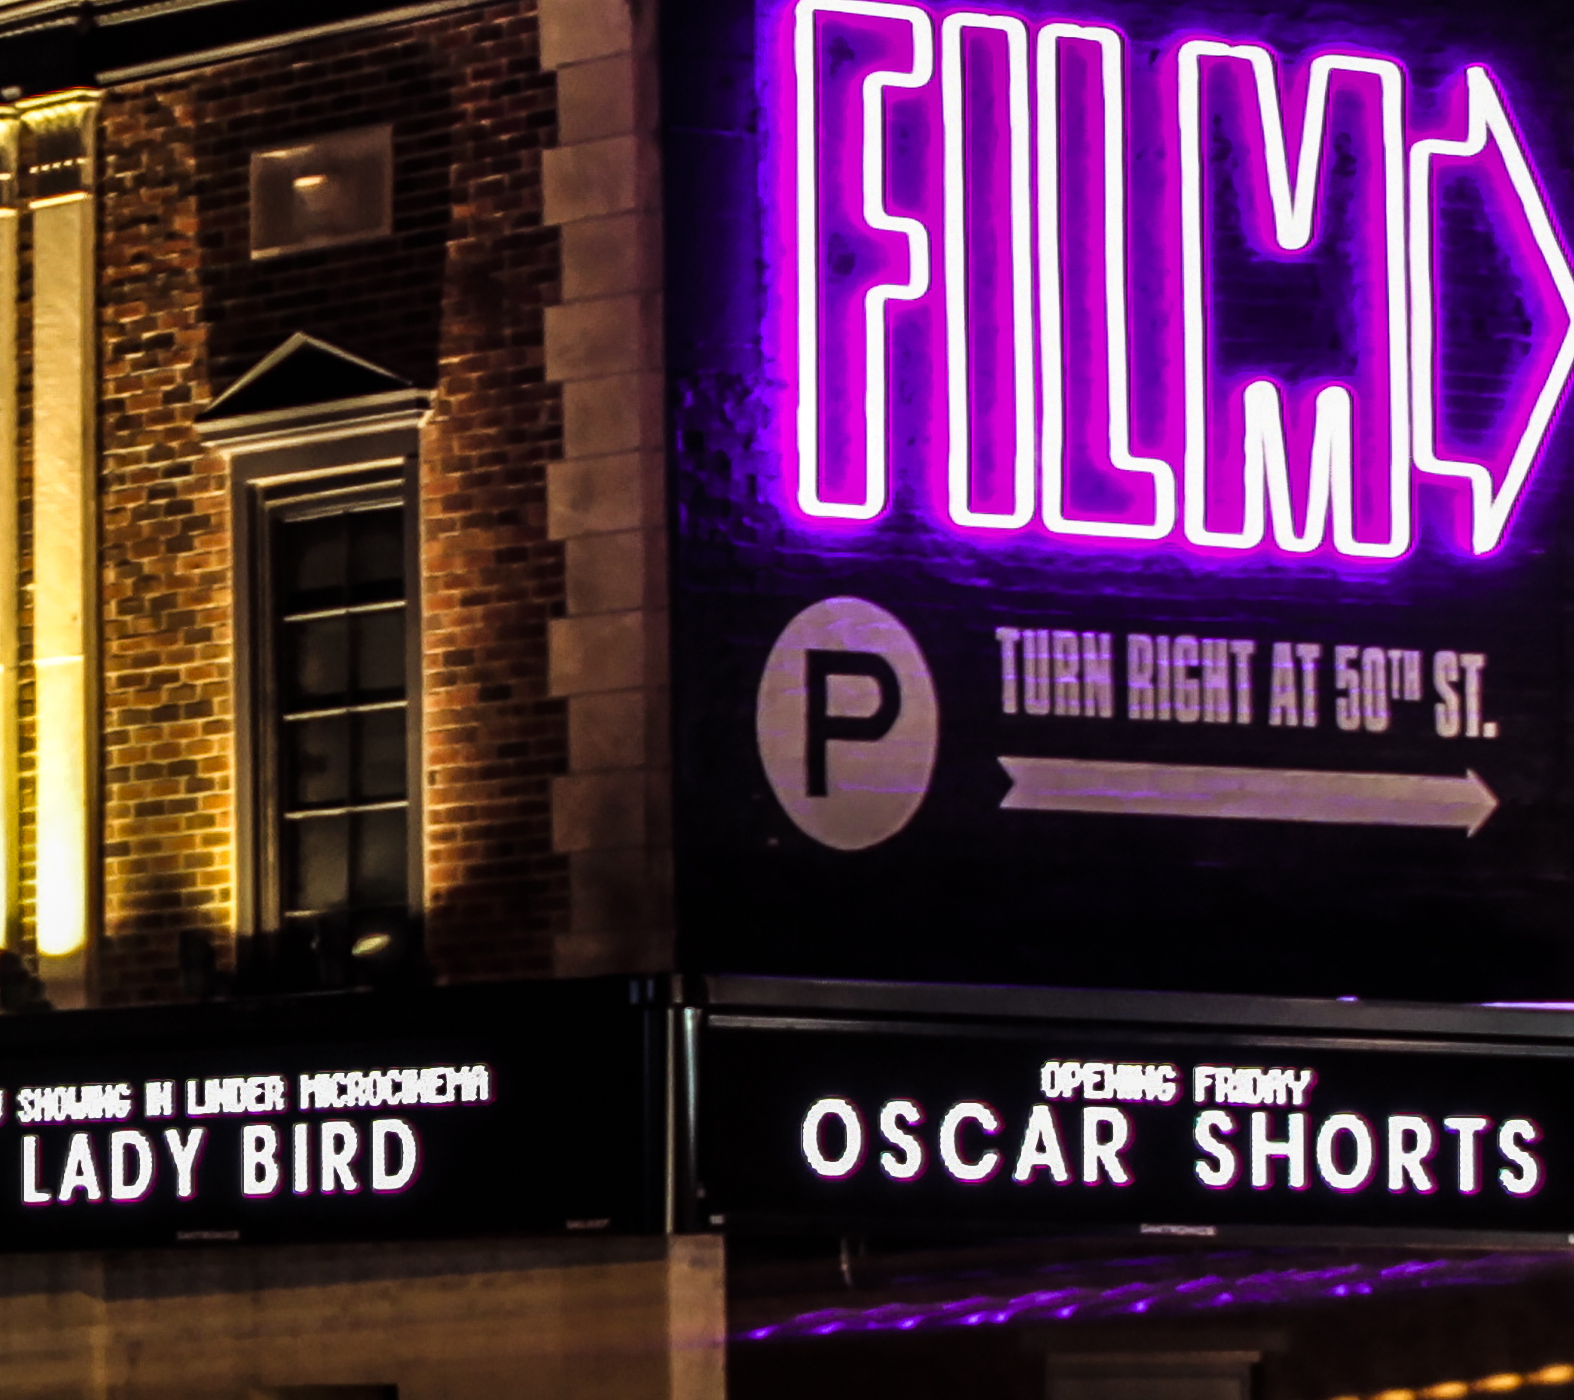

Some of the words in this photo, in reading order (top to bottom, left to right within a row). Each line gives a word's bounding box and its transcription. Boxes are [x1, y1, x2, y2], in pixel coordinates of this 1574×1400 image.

[804, 648, 903, 798] P
[995, 626, 1114, 719] TURN
[1127, 633, 1255, 725] RIGHT
[1268, 641, 1322, 728] AT
[1434, 650, 1499, 738] ST.
[16, 1082, 131, 1124] SHOWING
[146, 1080, 173, 1117] IN
[300, 1064, 490, 1111] MICROCINEMA
[1040, 1059, 1178, 1103] OPENING
[1193, 1065, 1314, 1107] FRIDAY
[22, 1126, 207, 1205] LADY
[242, 1118, 419, 1197] BIRD
[800, 1097, 1134, 1186] OSCAR
[1192, 1111, 1544, 1196] SHORTS
